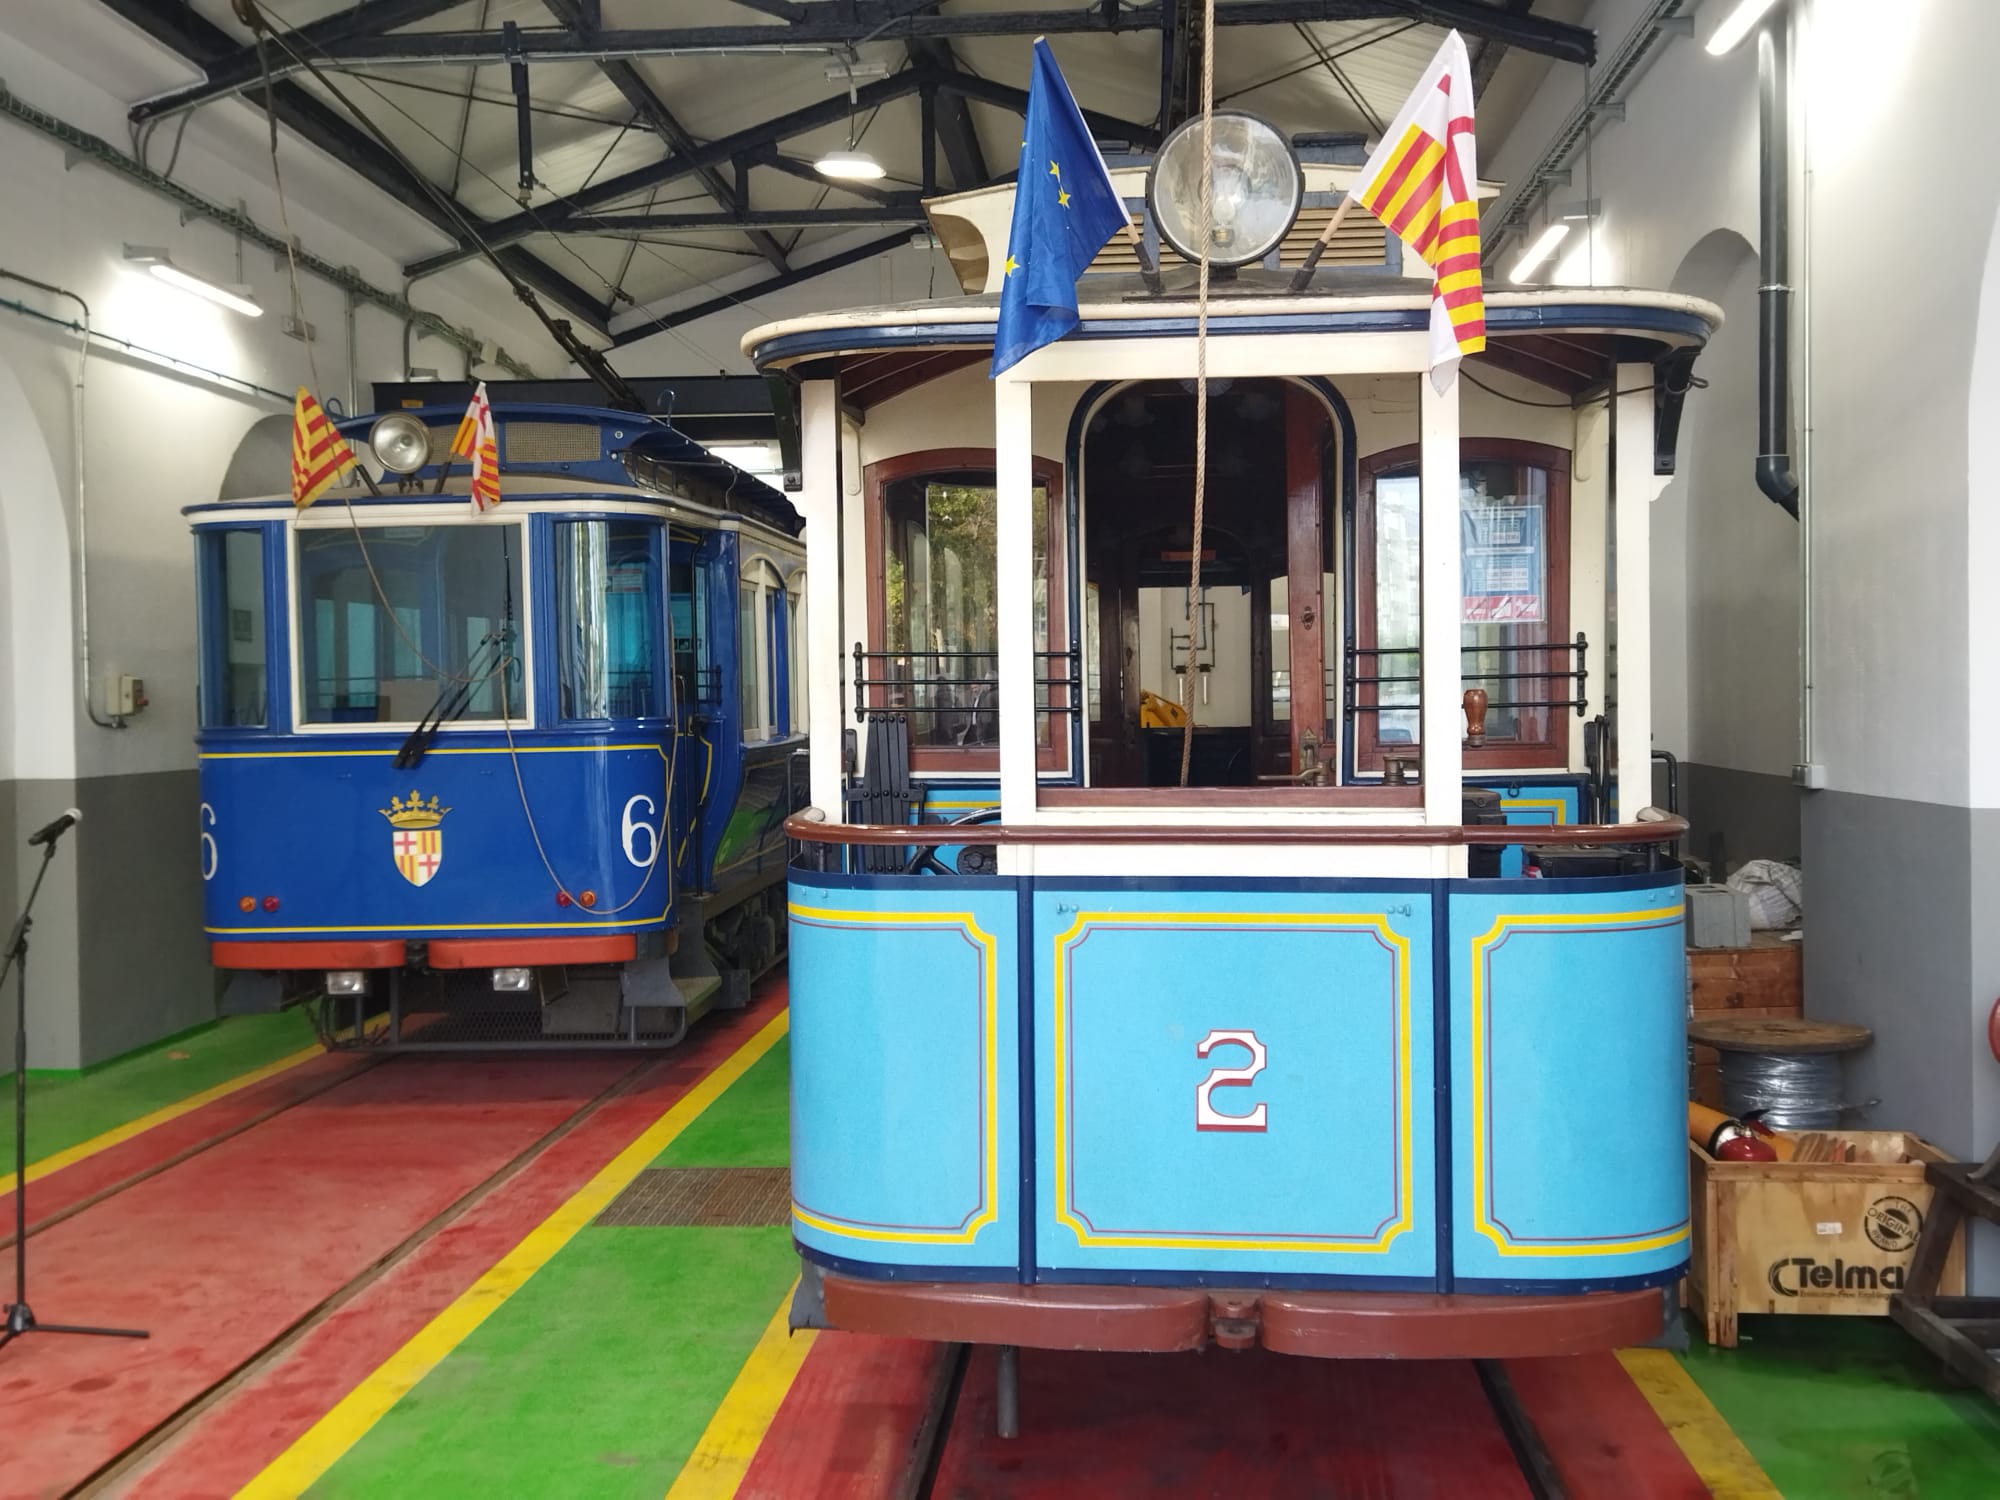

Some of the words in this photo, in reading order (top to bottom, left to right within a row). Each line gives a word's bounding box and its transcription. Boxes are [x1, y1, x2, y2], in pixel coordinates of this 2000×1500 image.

[622, 794, 657, 868] 6
[1196, 1029, 1267, 1133] 2
[1790, 1257, 1904, 1290] Telma
